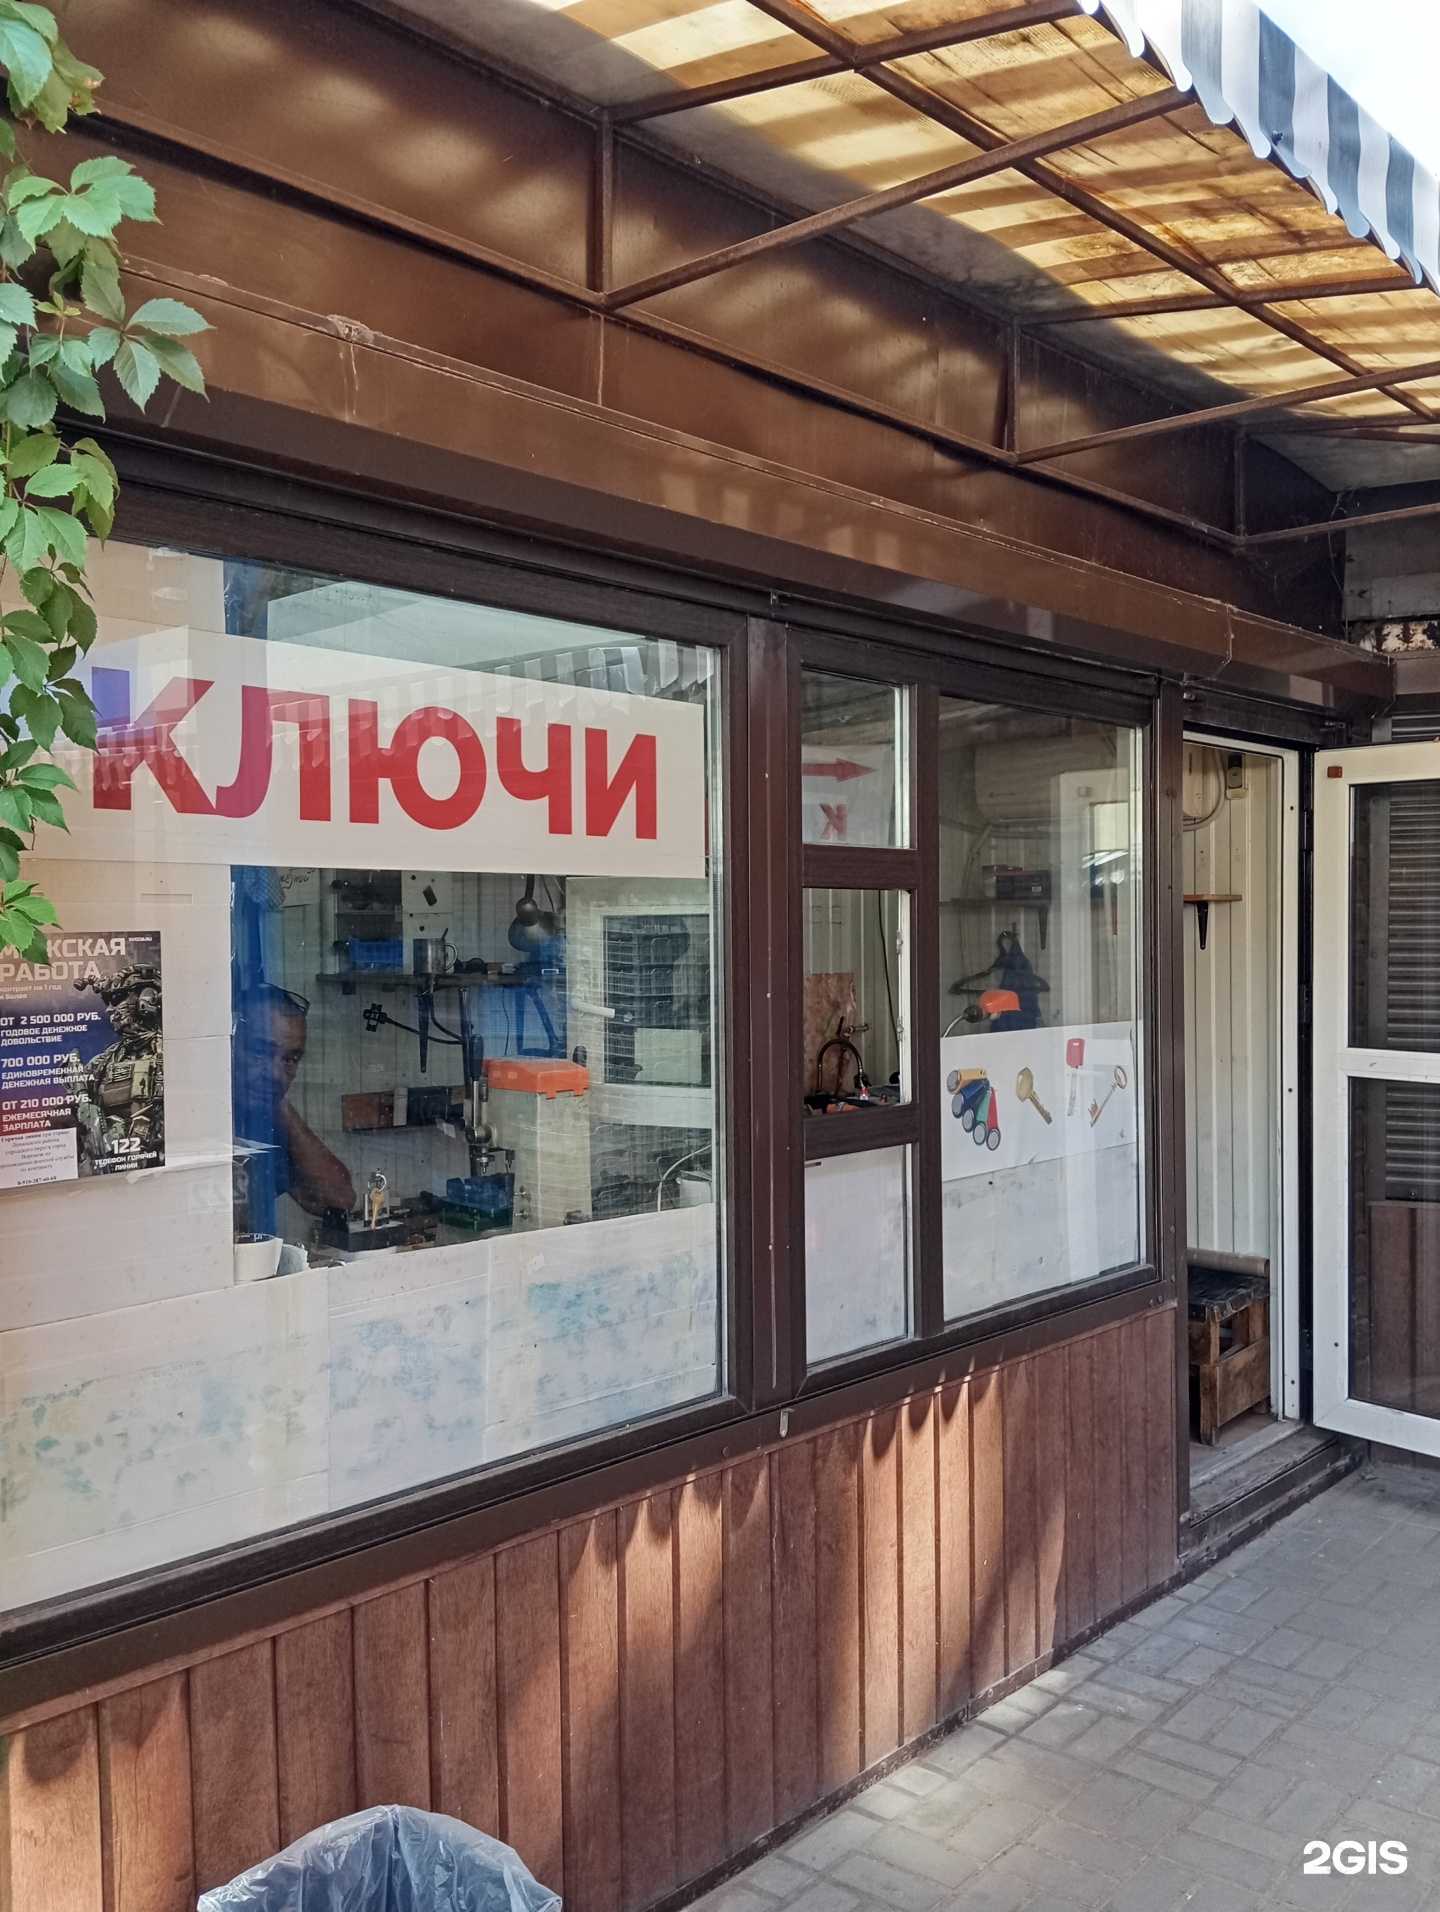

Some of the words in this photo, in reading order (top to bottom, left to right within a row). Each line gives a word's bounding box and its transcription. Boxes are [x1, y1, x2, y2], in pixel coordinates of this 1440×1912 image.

[91, 666, 658, 841] КЛЮЧИ
[0, 961, 101, 982] РАБОТА
[0, 1017, 15, 1026] ОТ
[20, 1016, 27, 1025] 2
[30, 1015, 50, 1024] 500
[53, 1013, 74, 1023] 000
[77, 1012, 101, 1021] РУБ.
[0, 1028, 40, 1037] ГОДОВОЕ
[41, 1024, 88, 1035] ДЕНЕЖНОЕ
[0, 1035, 62, 1047] ДОВОЛЬСТВИЕ
[1, 1057, 24, 1068] 700
[26, 1055, 50, 1066] 000
[53, 1053, 80, 1064] РУБ.
[1, 1066, 84, 1080] ЕДИНОВРЕМЕННАЯ
[1, 1078, 51, 1089] ДЕНЕЖНАЯ
[53, 1074, 95, 1084] ВЫПЛАТА
[2, 1100, 18, 1110] ОТ
[20, 1098, 39, 1109] 210
[42, 1096, 64, 1107] 000
[66, 1093, 92, 1104] РУБ.
[2, 1108, 72, 1122] ЕЖЕМЕСЯЧНАЯ
[2, 1119, 51, 1132] ЗАРПЛАТА
[111, 1137, 141, 1154] 122
[94, 1156, 126, 1166] ТЕЛЕФОН
[127, 1151, 157, 1161] ГОРЯЧЕЙ
